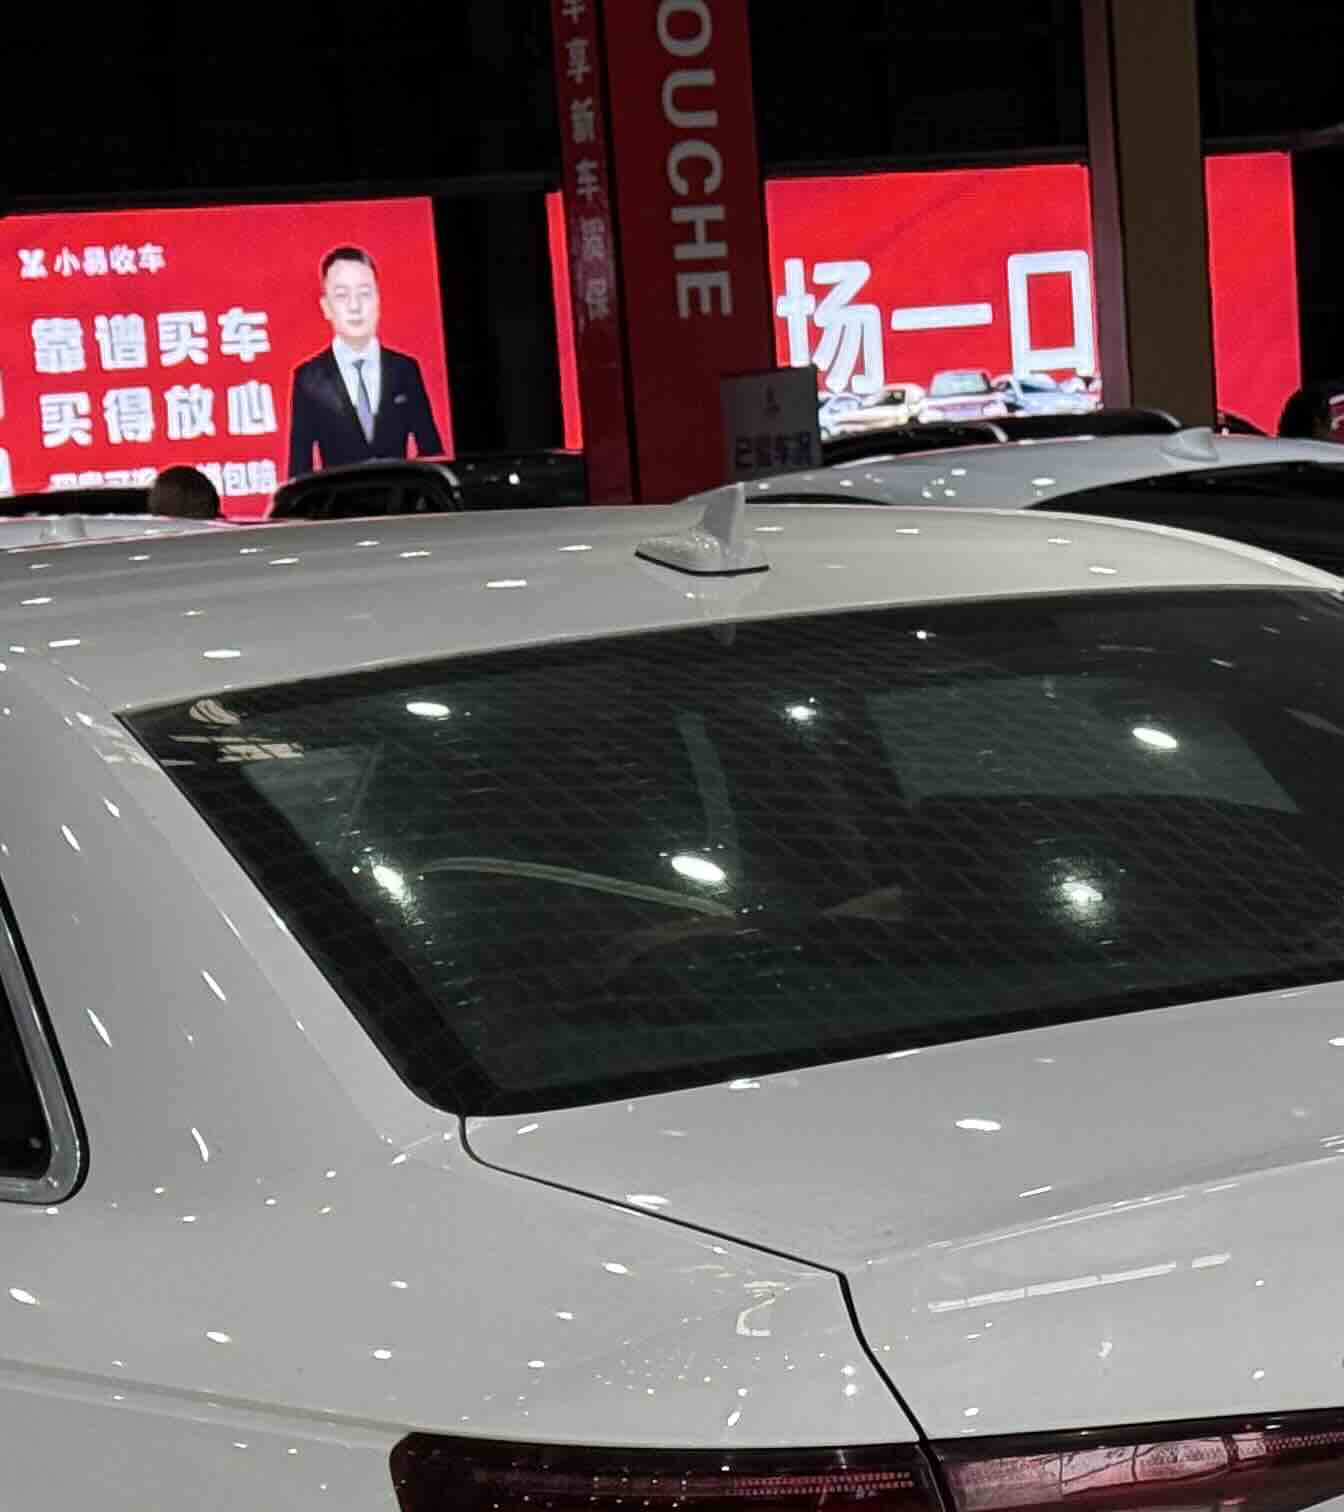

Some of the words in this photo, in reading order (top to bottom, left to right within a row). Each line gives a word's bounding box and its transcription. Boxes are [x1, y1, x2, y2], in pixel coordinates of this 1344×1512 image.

[53, 241, 167, 277] 小易收车
[30, 305, 272, 375] 靠谱买车
[38, 378, 278, 448] 买得放心
